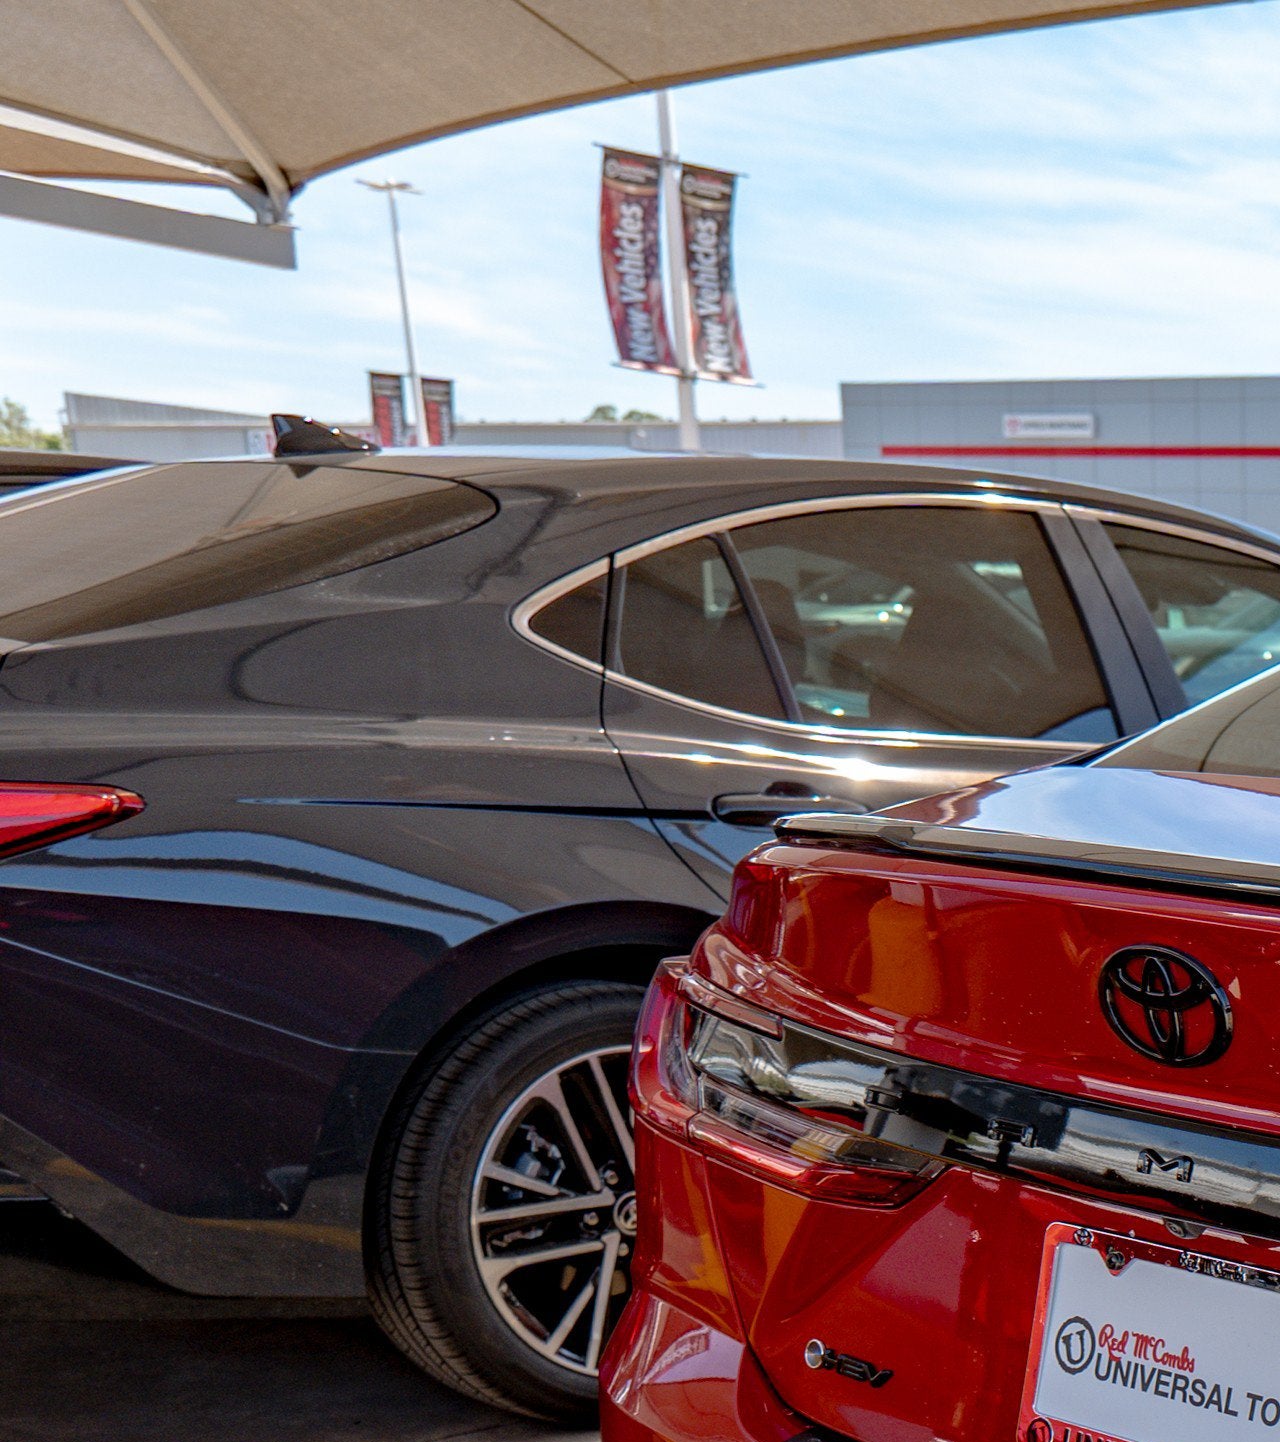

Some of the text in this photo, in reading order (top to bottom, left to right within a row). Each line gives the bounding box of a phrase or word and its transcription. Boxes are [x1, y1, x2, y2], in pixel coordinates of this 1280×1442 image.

[613, 202, 647, 304] Vehicles
[689, 217, 722, 317] Vehicles
[627, 304, 659, 363] New
[703, 316, 735, 372] New
[1099, 1323, 1195, 1373] Red McCombs
[1094, 1353, 1238, 1417] UNIVERSAL
